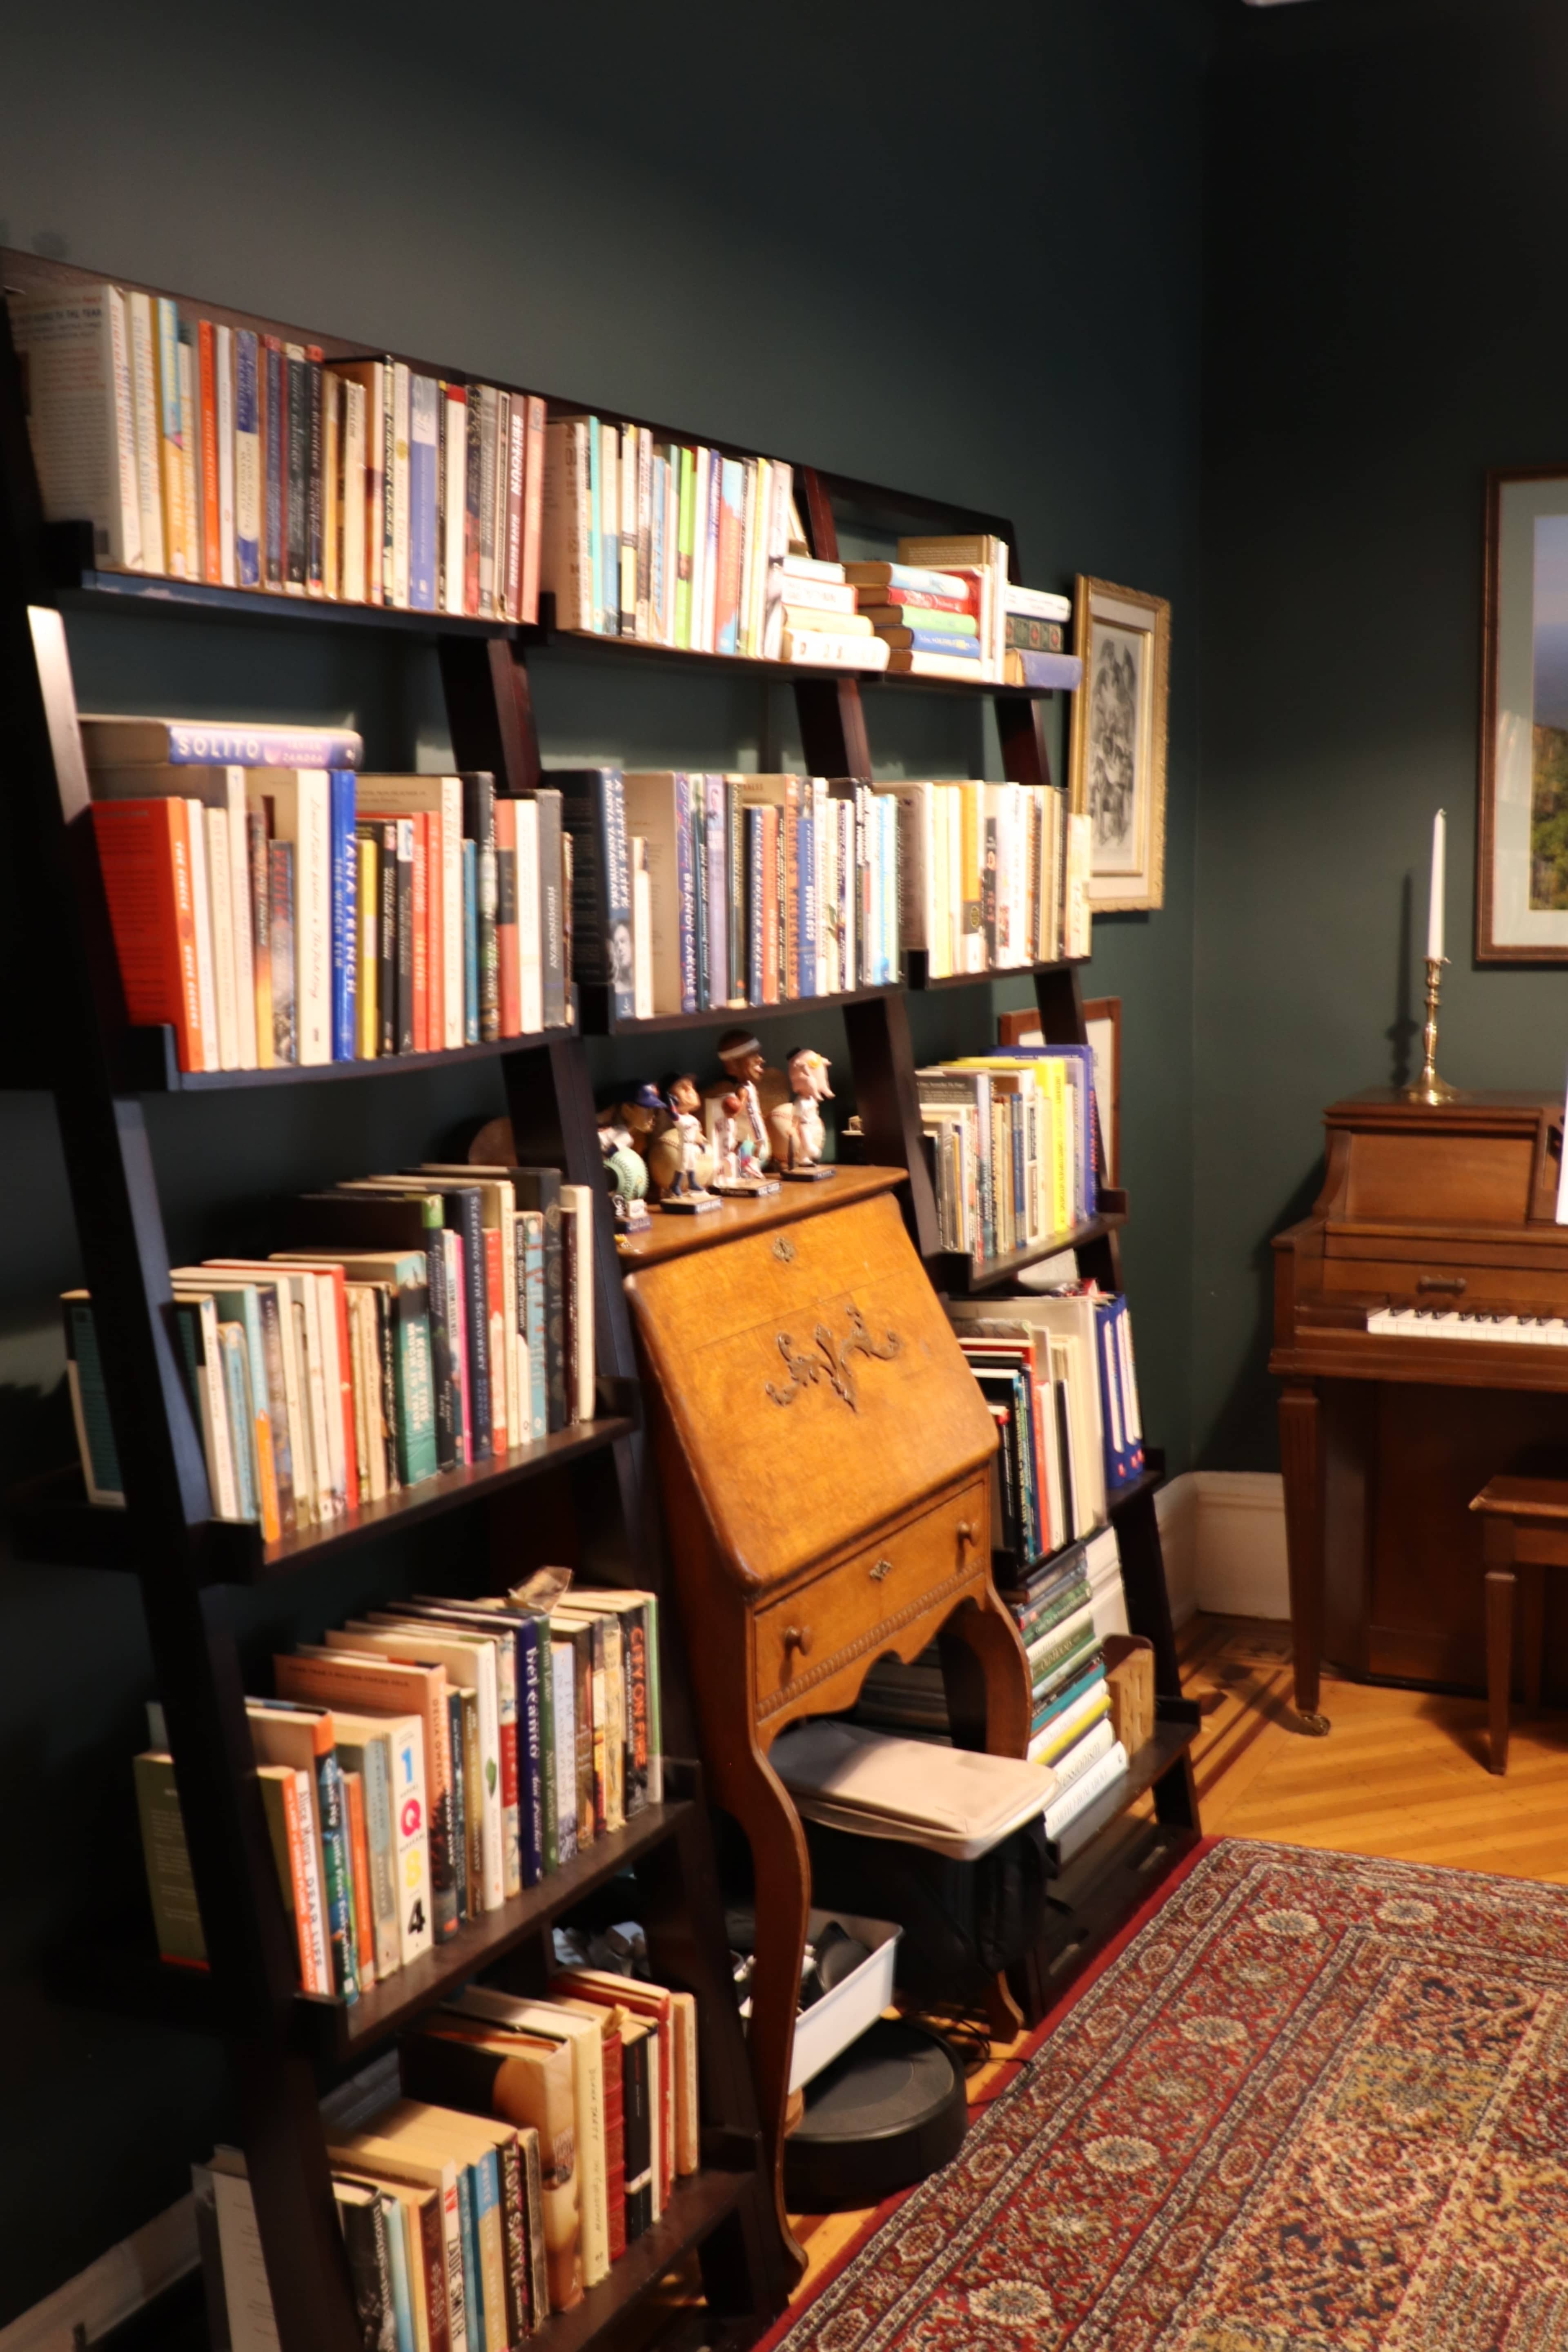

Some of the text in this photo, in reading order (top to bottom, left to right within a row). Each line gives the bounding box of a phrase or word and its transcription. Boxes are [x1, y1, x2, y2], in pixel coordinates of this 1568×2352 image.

[511, 413, 523, 496] ZEITOUN
[178, 734, 260, 758] SOLITO
[443, 788, 454, 870] HARRIS
[605, 779, 620, 908] HANYA YANAGIHARA
[616, 797, 628, 861] LITTLE
[345, 831, 357, 995] TANA FRENCH
[546, 885, 558, 970] HEMINGWAY
[619, 866, 630, 909] LIFE
[789, 886, 798, 977] WILDERNESS
[805, 885, 814, 941] DOUGLASS
[175, 841, 199, 1029] THE CIRCLE DAVE EGGERS
[683, 873, 697, 996] BRANDI CARLILE
[470, 1196, 486, 1371] SLEEPING WITH SCHUBERT
[516, 1225, 524, 1256] Black
[518, 1295, 526, 1329] Green
[407, 1323, 421, 1431] MUCH IS TRUE
[415, 1338, 426, 1384] KNOW
[418, 1387, 428, 1422] THIS
[432, 1698, 444, 1787] DELIA OWENS
[543, 1641, 556, 1832] Tom Lake Ann Patchett
[565, 1680, 573, 1719] TIM
[630, 1627, 647, 1769] CITY ON FIRE
[525, 1645, 543, 1853] bel canto Ann Patchett
[298, 1790, 323, 1968] Alice Munro DEAR LIFE
[325, 1757, 352, 1974] Celeste Ng Little Fires Everywhere
[447, 1835, 455, 1866] SING
[481, 2160, 492, 2205] WHITE
[503, 2147, 525, 2287] ZADIE SMITH
[445, 2185, 466, 2341] NW ZADIE SMITH
